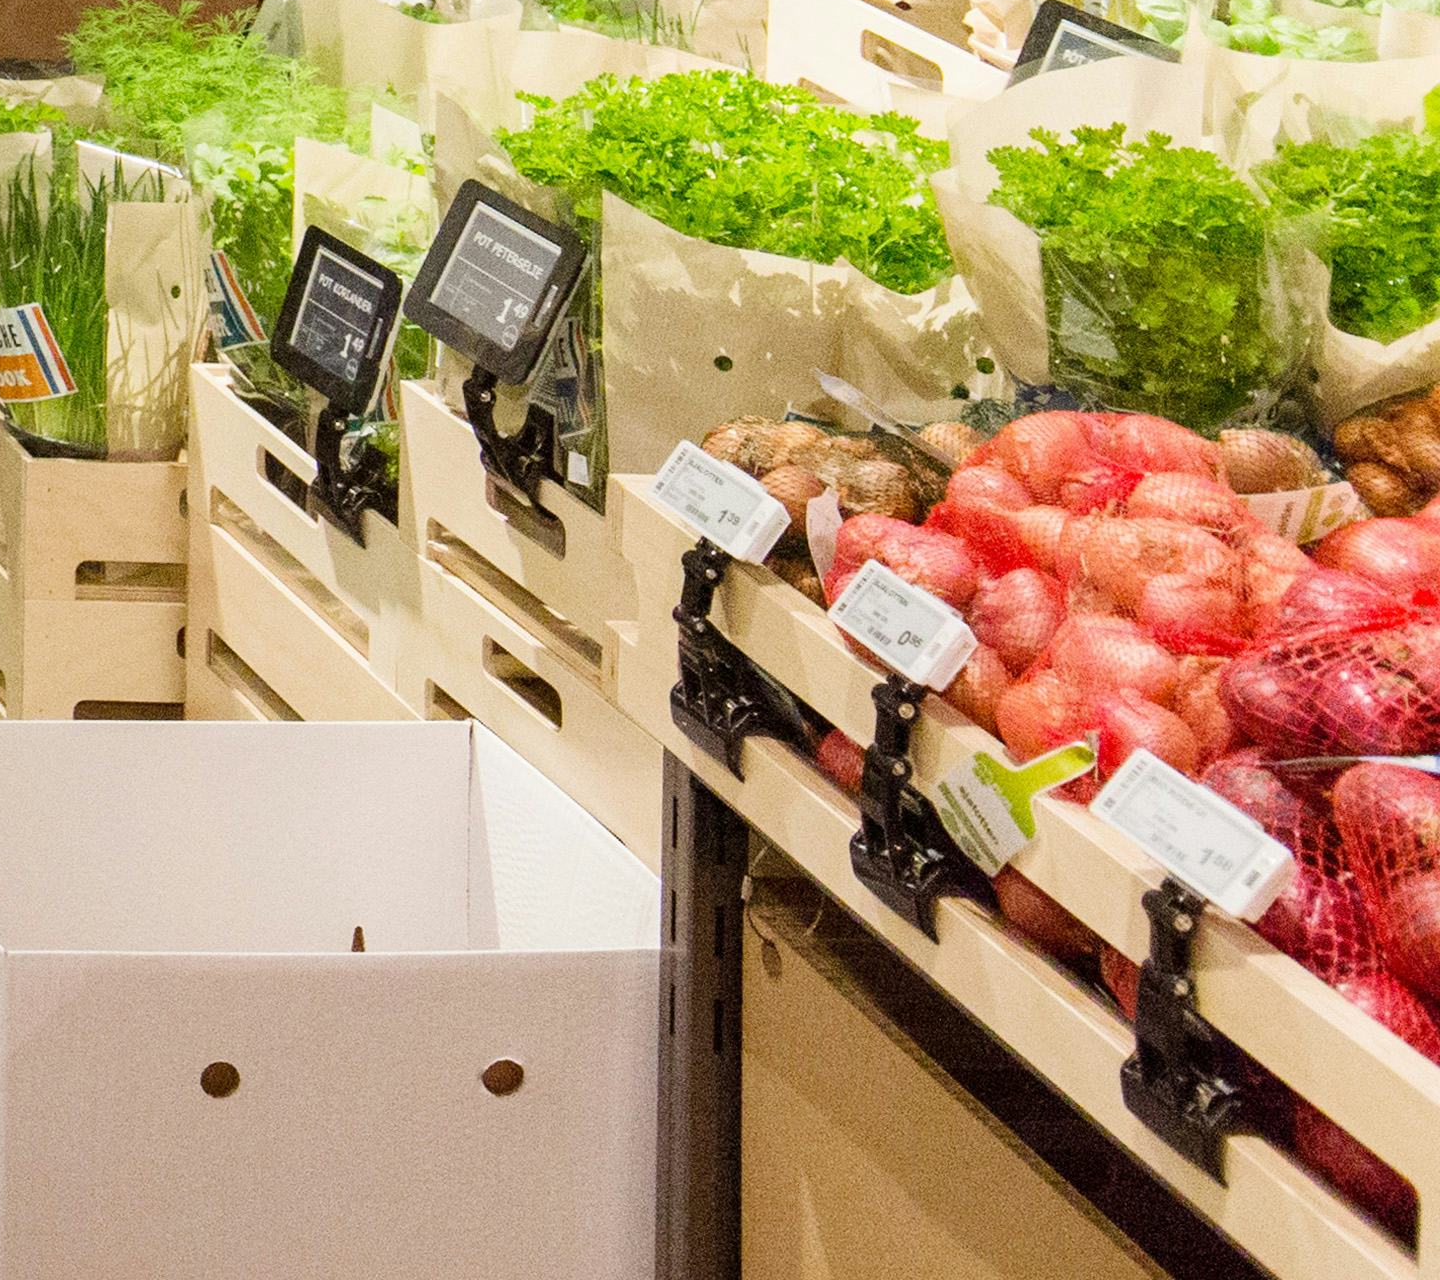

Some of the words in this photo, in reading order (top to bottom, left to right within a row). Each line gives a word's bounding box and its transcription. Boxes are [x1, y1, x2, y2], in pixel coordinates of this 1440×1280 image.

[474, 232, 491, 250] POT
[491, 238, 544, 280] PETERSELIE
[319, 274, 332, 290] POT
[332, 280, 372, 314] KORIANDER
